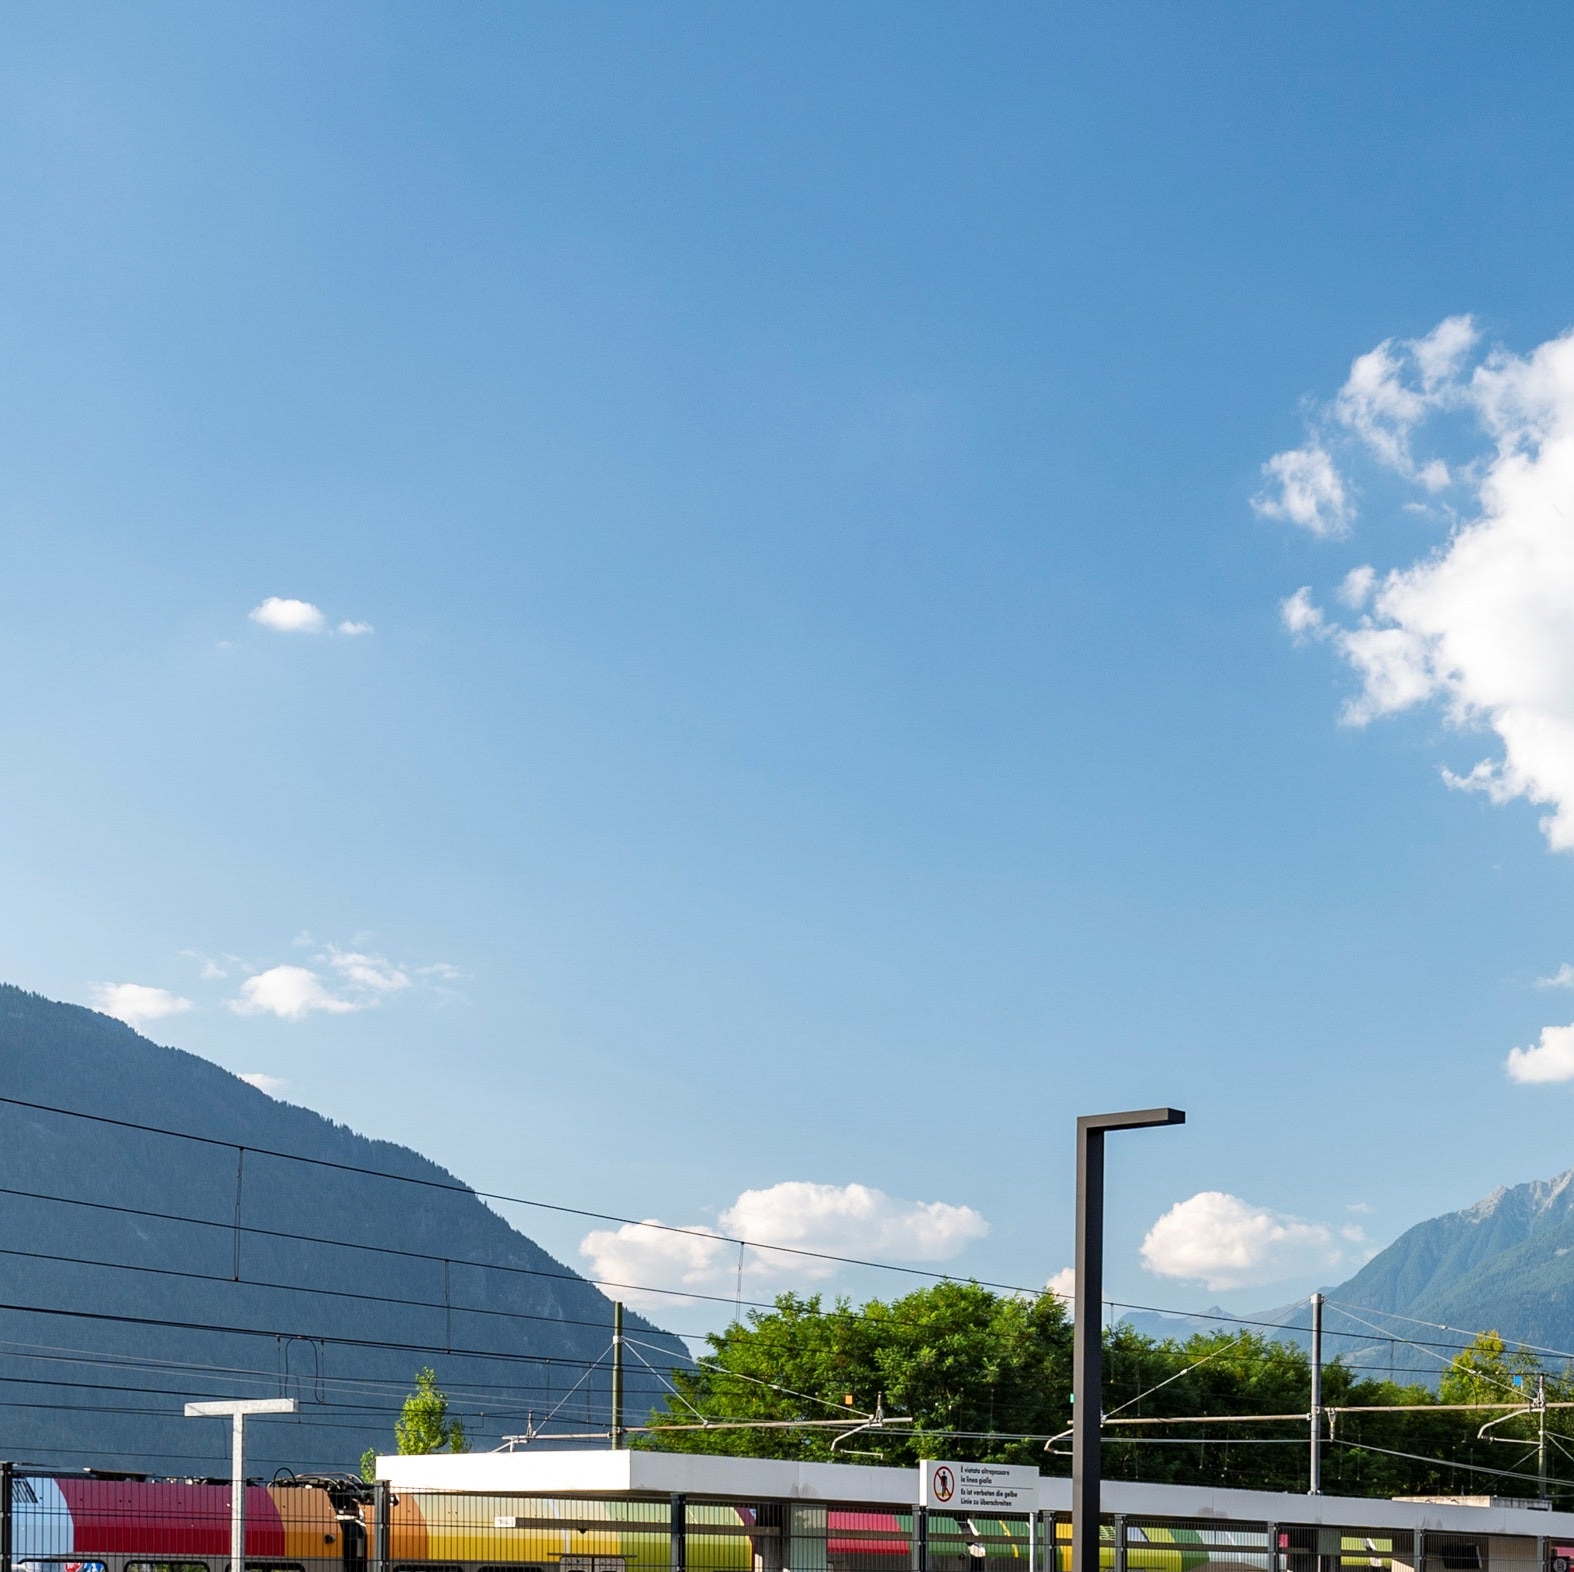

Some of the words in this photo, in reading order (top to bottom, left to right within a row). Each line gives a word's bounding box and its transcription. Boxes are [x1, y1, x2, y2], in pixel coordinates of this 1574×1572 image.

[964, 1466, 980, 1474] vietato
[979, 1477, 992, 1485] gialla
[1004, 1491, 1017, 1499] gelbe
